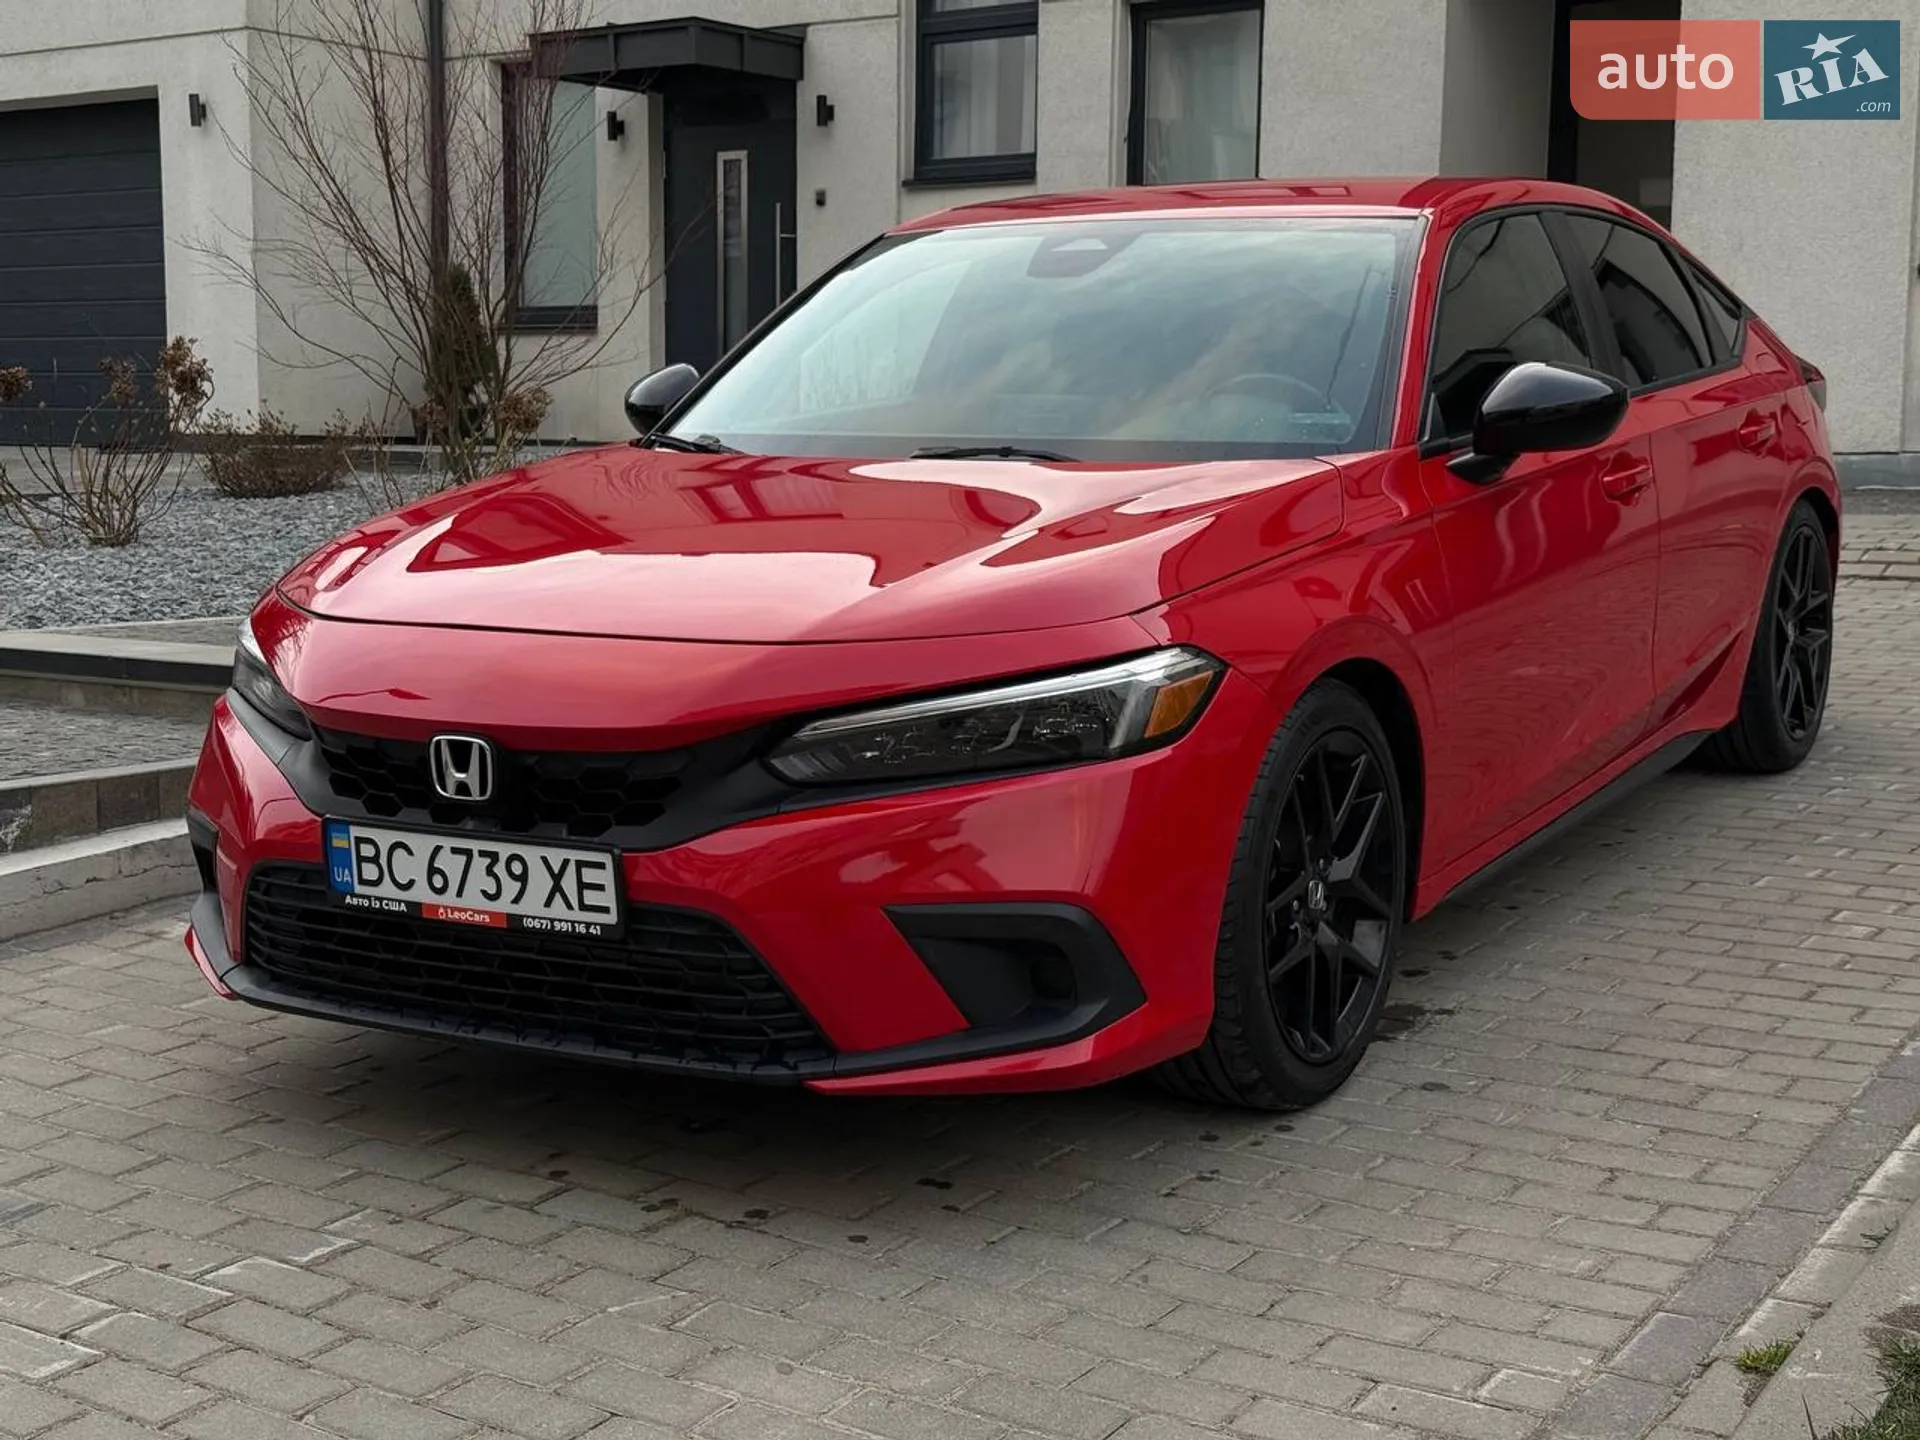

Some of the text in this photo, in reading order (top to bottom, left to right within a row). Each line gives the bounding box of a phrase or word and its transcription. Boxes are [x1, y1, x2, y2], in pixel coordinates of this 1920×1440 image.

[334, 867, 351, 883] UA
[354, 835, 610, 914] BC 6739 XE
[345, 895, 369, 907] Авто
[382, 901, 407, 912] США
[447, 909, 490, 923] LeoCars
[523, 917, 601, 935] (067) 991 16 41
